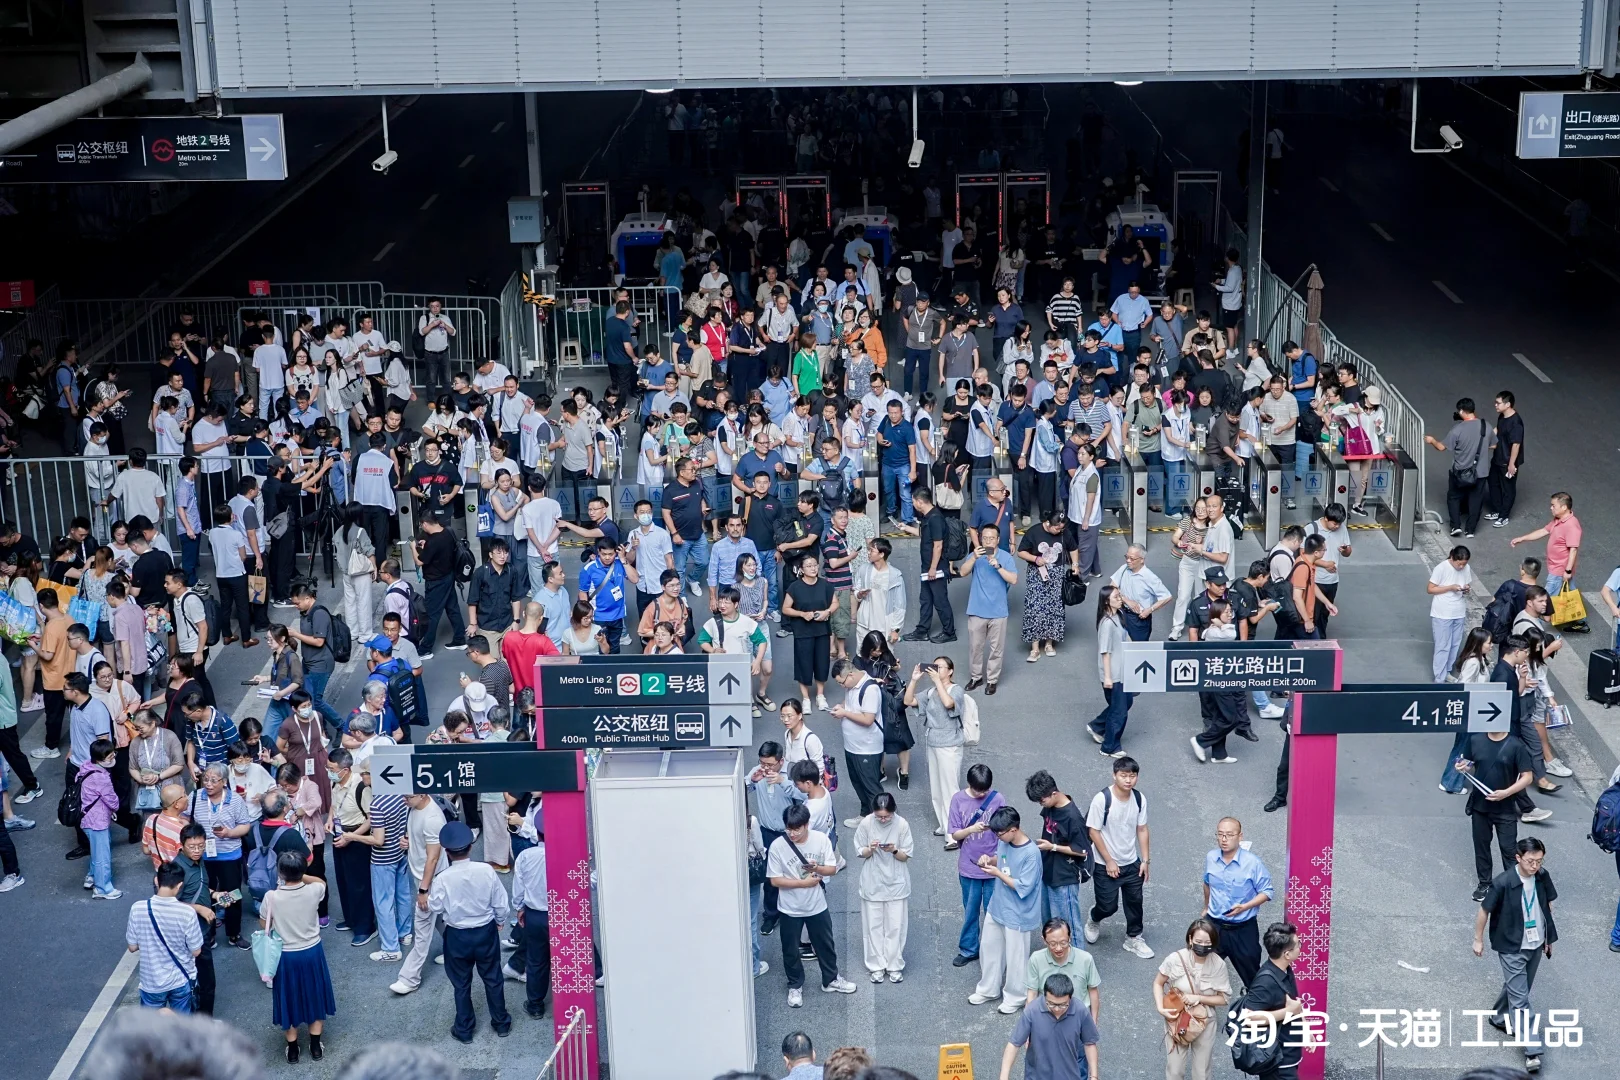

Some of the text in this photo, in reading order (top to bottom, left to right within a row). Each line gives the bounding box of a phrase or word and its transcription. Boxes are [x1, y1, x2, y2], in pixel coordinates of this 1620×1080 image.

[77, 141, 129, 154] 公交枢纽
[1204, 656, 1304, 675] 诸光路出口
[559, 676, 584, 684] Metro
[586, 676, 605, 684] Line
[1204, 678, 1317, 688] Zhuguang Road Exit 200m
[594, 686, 613, 694] 50m
[1401, 701, 1439, 726] 4.1
[1446, 699, 1465, 717] 馆
[592, 714, 669, 733] 公交枢纽
[1444, 717, 1462, 725] Hall
[595, 734, 670, 743] Public Transit Hub
[416, 764, 453, 788] 5.1
[457, 761, 475, 778] 馆
[458, 778, 475, 787] Hall
